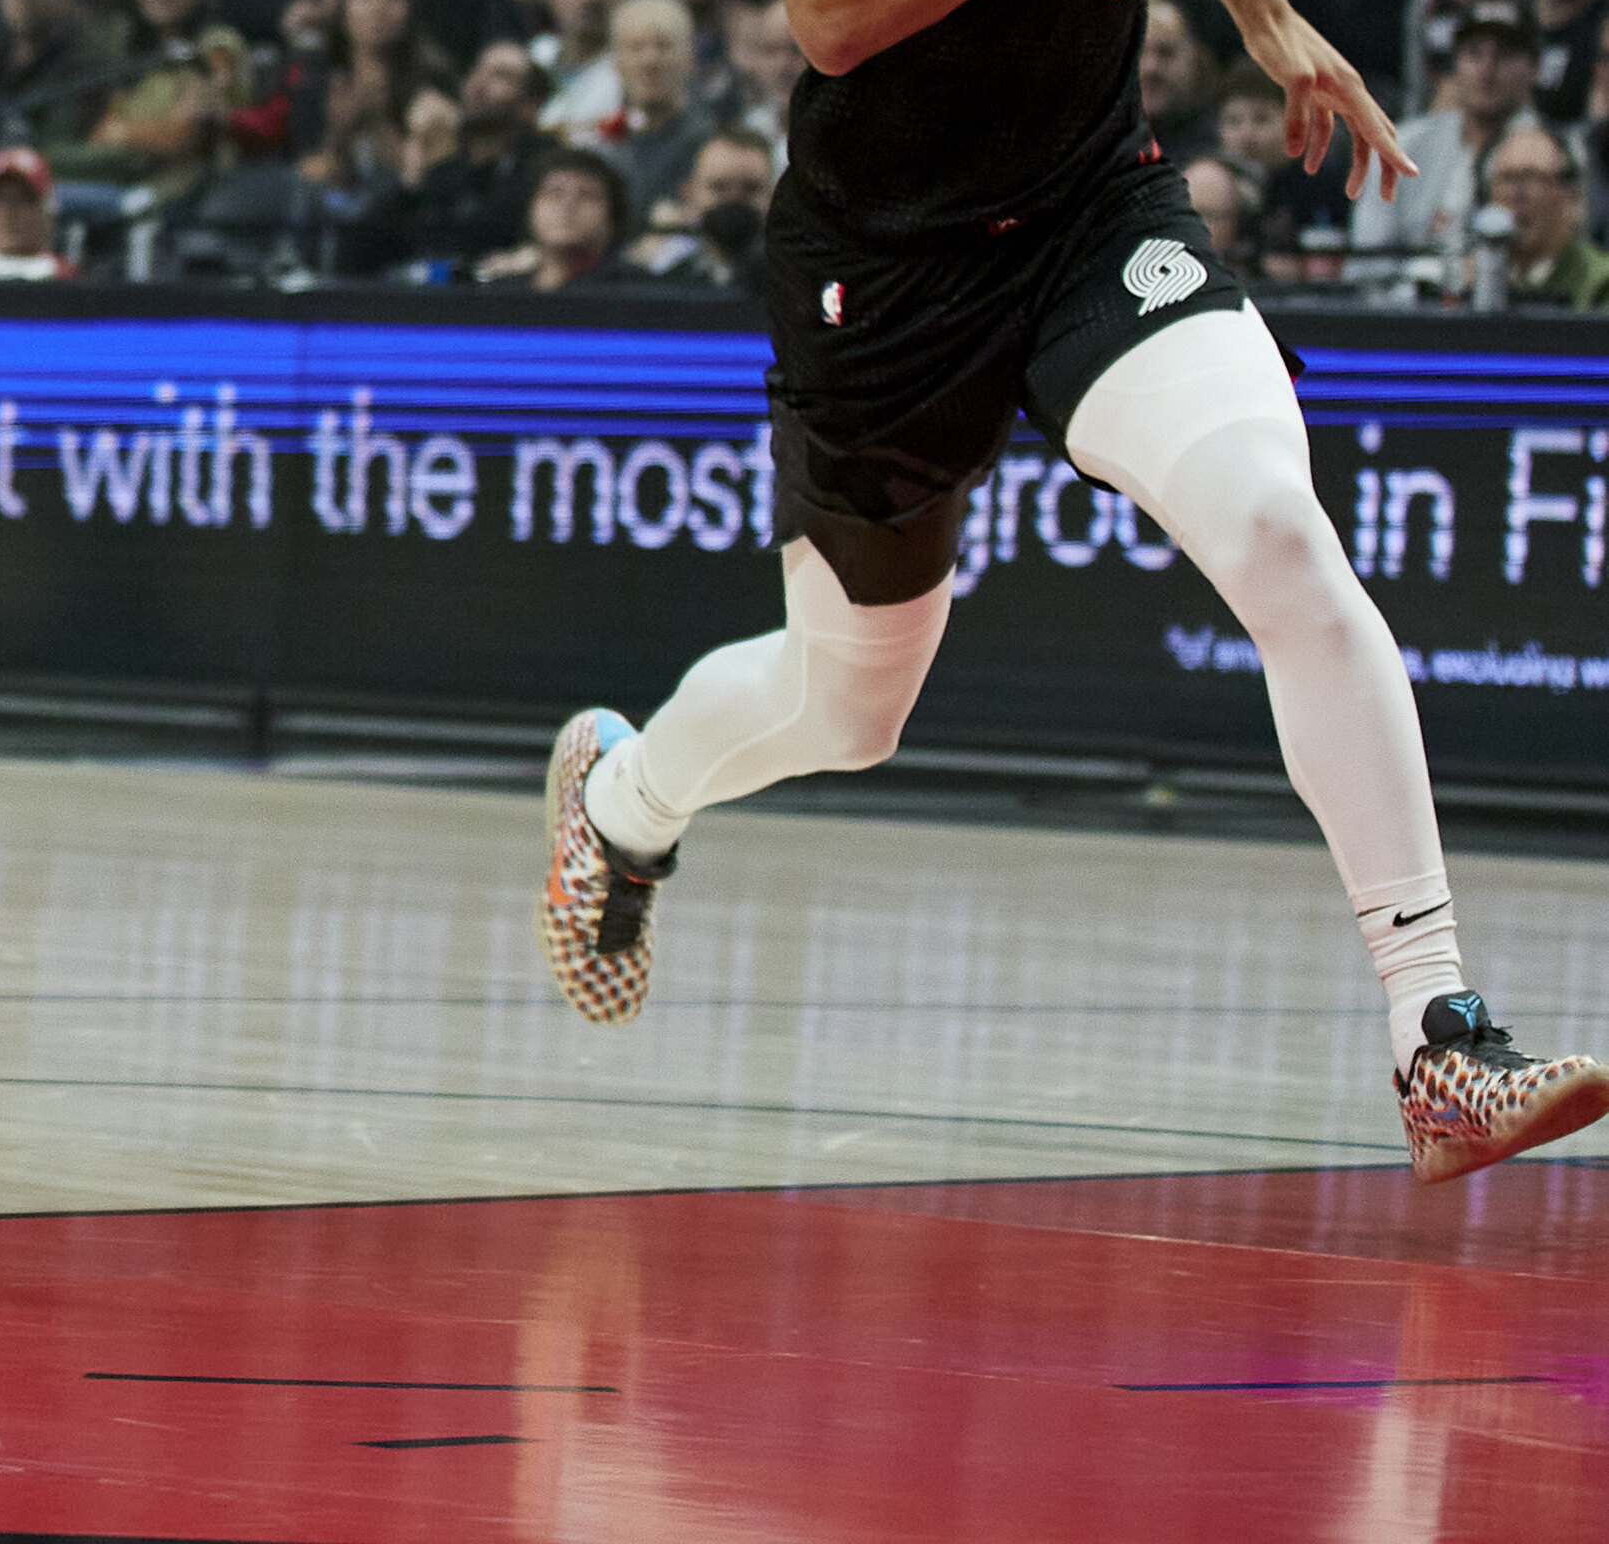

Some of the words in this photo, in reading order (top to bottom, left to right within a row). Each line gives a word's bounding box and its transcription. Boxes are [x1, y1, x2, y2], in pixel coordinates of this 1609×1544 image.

[57, 379, 275, 530] with
[307, 384, 477, 540] the
[509, 420, 774, 553] most
[1353, 418, 1457, 582] in
[1502, 427, 1609, 589] Fi
